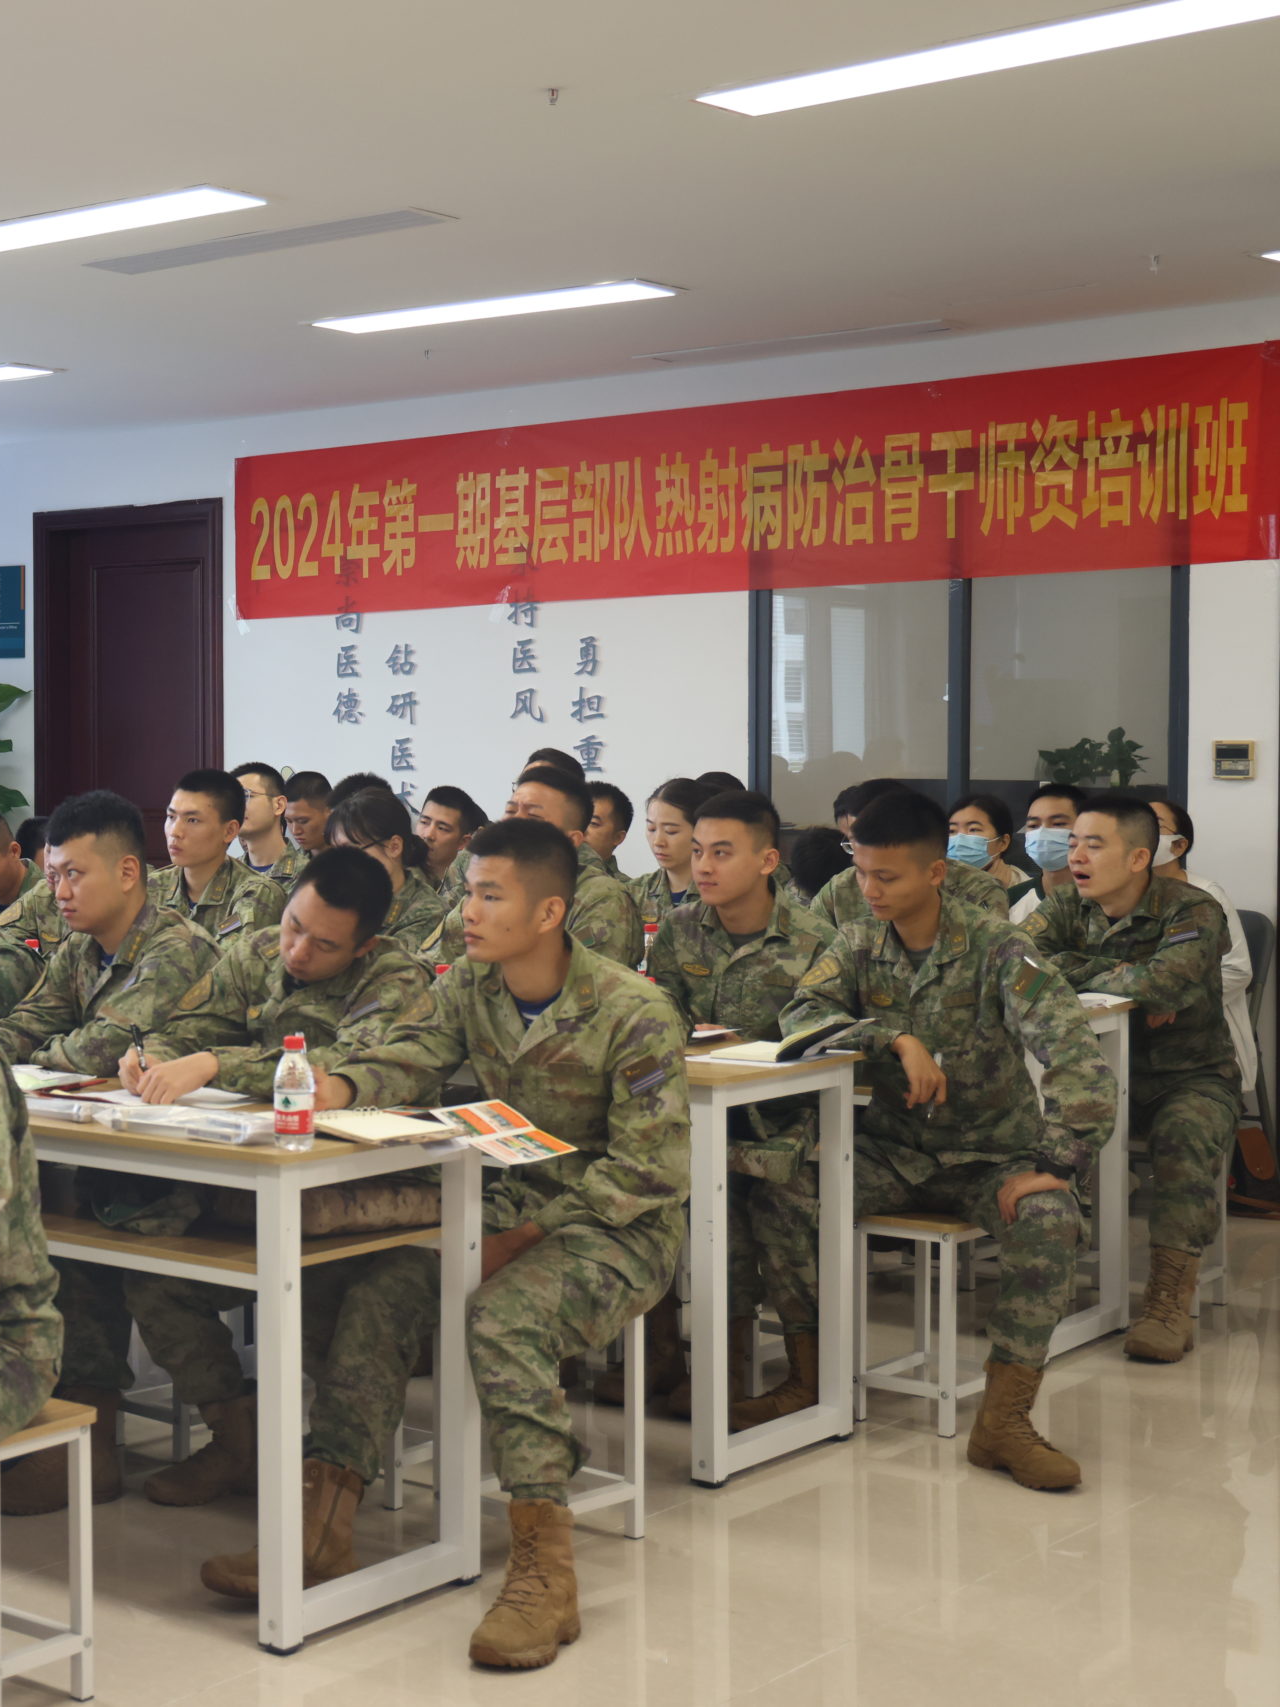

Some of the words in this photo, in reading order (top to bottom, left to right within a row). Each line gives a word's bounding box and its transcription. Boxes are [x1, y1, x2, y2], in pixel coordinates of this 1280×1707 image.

[251, 397, 1249, 581] 2024年第一期基层部队热射病防治骨干师资培训班
